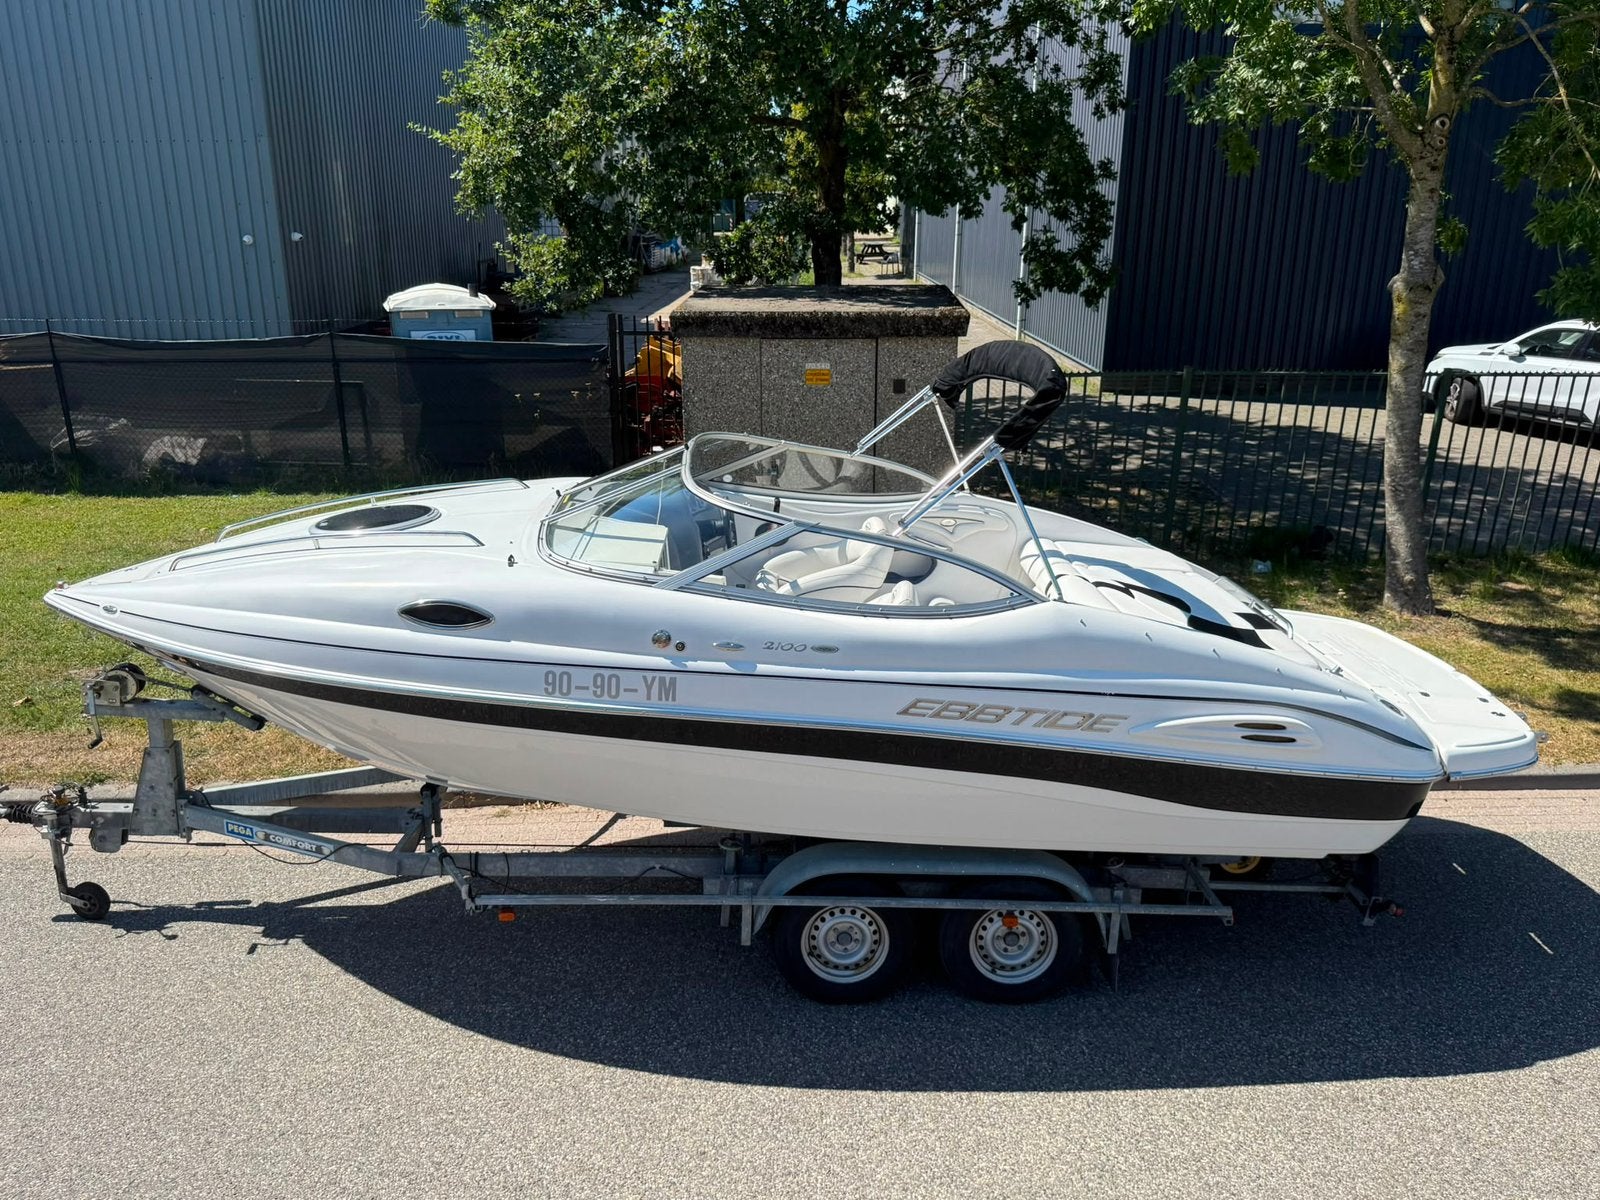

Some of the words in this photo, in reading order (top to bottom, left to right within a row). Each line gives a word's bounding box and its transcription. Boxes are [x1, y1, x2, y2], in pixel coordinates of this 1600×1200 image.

[762, 641, 807, 653] 2100
[543, 670, 677, 702] 90-90-YM
[896, 698, 1128, 733] EBBTIDE
[227, 822, 253, 837] PEGA
[269, 834, 317, 852] COMFORT
